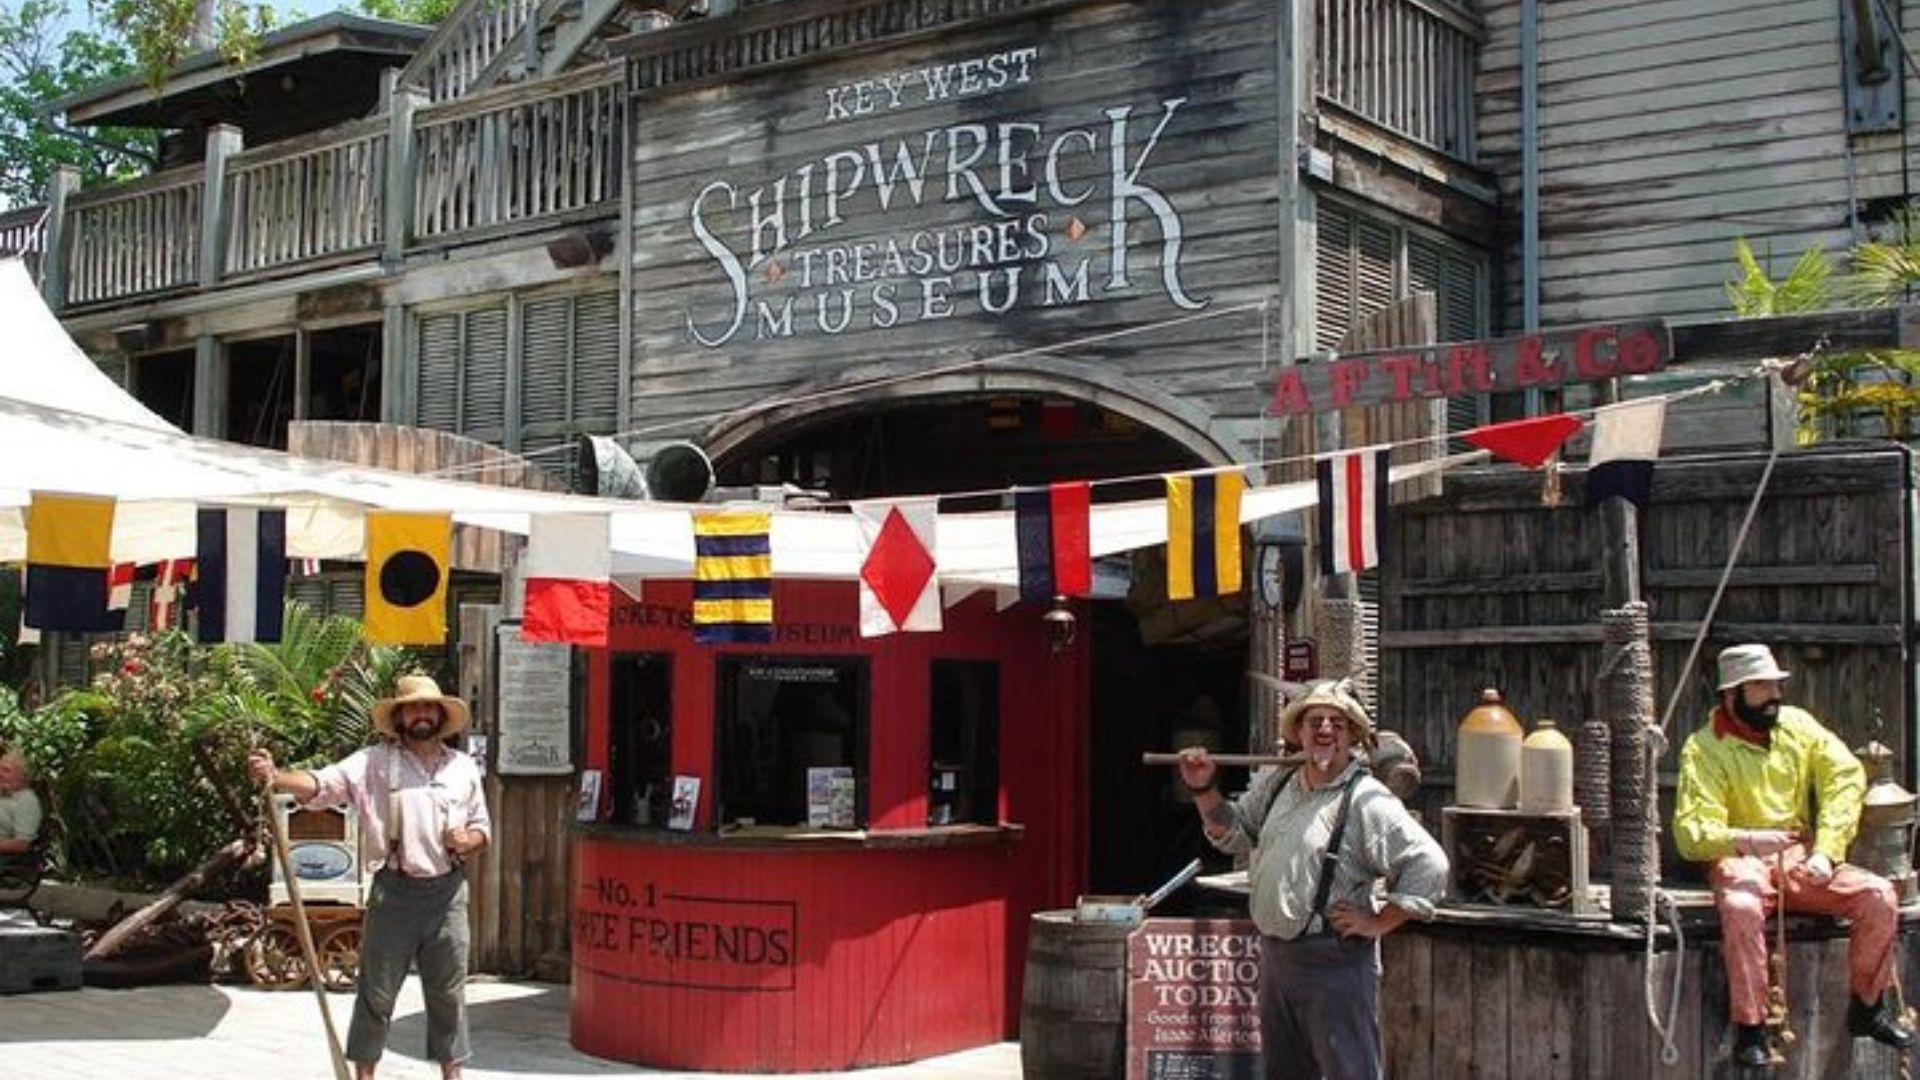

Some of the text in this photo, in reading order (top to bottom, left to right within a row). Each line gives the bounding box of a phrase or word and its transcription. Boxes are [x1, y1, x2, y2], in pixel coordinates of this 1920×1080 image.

[825, 47, 1038, 120] KEY WEST
[687, 97, 1212, 348] SHIPWRECK
[794, 213, 1050, 289] TREASURES
[756, 257, 1091, 340] MUSEUM
[1265, 366, 1314, 417] A
[1379, 340, 1496, 399] Tift
[1512, 332, 1566, 385] &
[1574, 323, 1663, 376] Co
[609, 604, 694, 632] ICKETS
[647, 882, 656, 908] 1
[628, 916, 790, 967] FRIENDS
[1145, 934, 1263, 958] WRECK
[1142, 958, 1260, 983] AUCTIO
[1153, 984, 1261, 1006] TODAY
